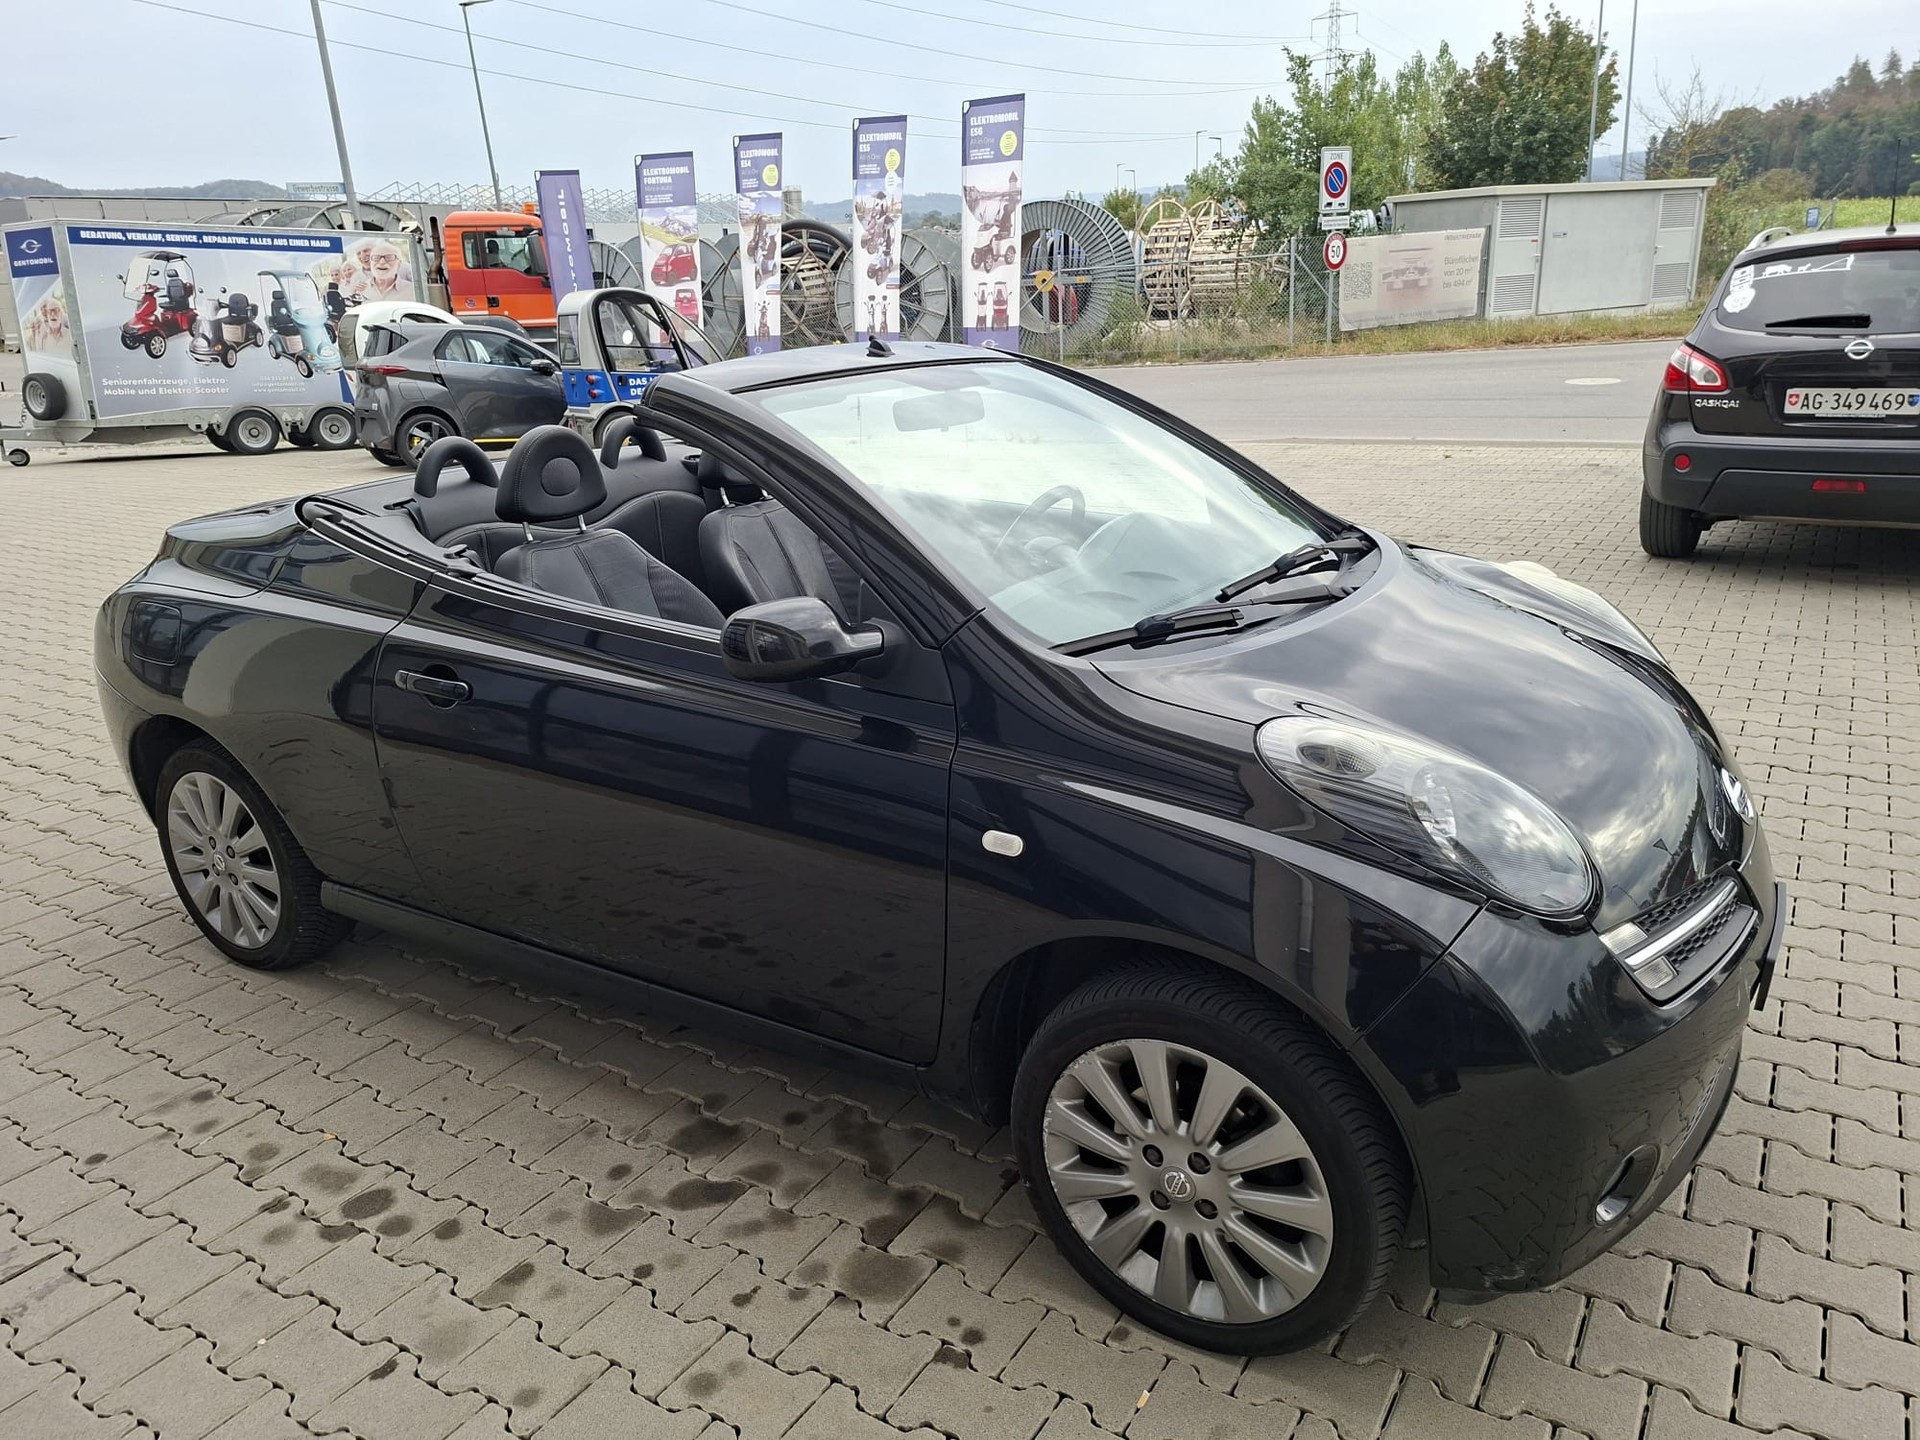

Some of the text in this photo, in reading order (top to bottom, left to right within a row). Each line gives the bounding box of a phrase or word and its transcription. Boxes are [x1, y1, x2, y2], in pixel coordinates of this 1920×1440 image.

[970, 112, 1019, 126] ELEKTROMOBIL
[859, 132, 902, 142] ELEKTROMOBIL
[741, 148, 779, 158] ELEKTROMOBIL
[1330, 152, 1344, 160] ZONE
[643, 166, 690, 176] ELEKTROMOBIL
[643, 176, 672, 185] FORTUNA
[80, 230, 126, 241] BERATUNG,
[127, 232, 165, 242] VERKAUF,
[166, 234, 198, 243] SERVICE
[250, 237, 272, 246] ALLES
[273, 238, 288, 246] AUS
[289, 239, 310, 247] EINER
[310, 239, 331, 247] HAND
[1331, 245, 1341, 258] 50
[13, 257, 54, 267] GENTOMOBIL
[629, 377, 648, 386] DAS
[104, 387, 136, 396] Mobile
[138, 387, 156, 395] und
[1694, 399, 1740, 408] QASHQAI
